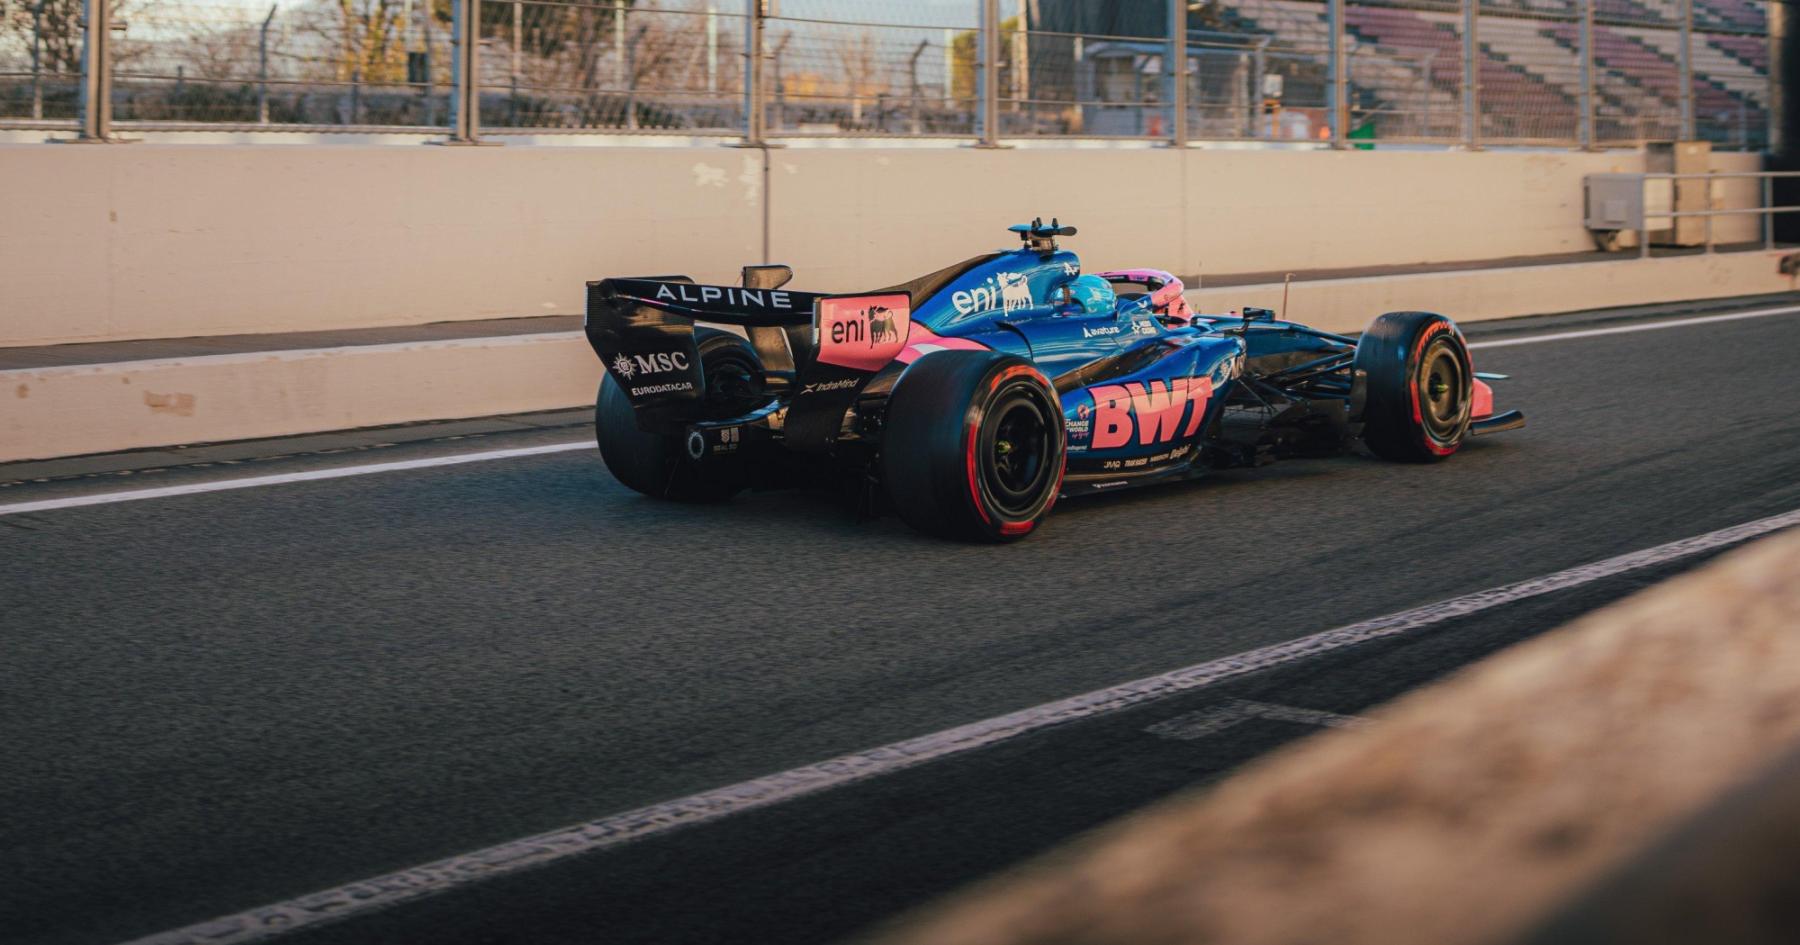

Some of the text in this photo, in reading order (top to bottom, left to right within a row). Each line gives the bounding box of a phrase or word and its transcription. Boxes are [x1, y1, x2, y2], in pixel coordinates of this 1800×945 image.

[656, 284, 792, 309] ALPINE
[952, 277, 996, 315] eni
[831, 310, 864, 344] eni
[634, 351, 689, 374] MSC
[631, 382, 693, 396] EURODATACAR
[1088, 375, 1214, 449] BWT
